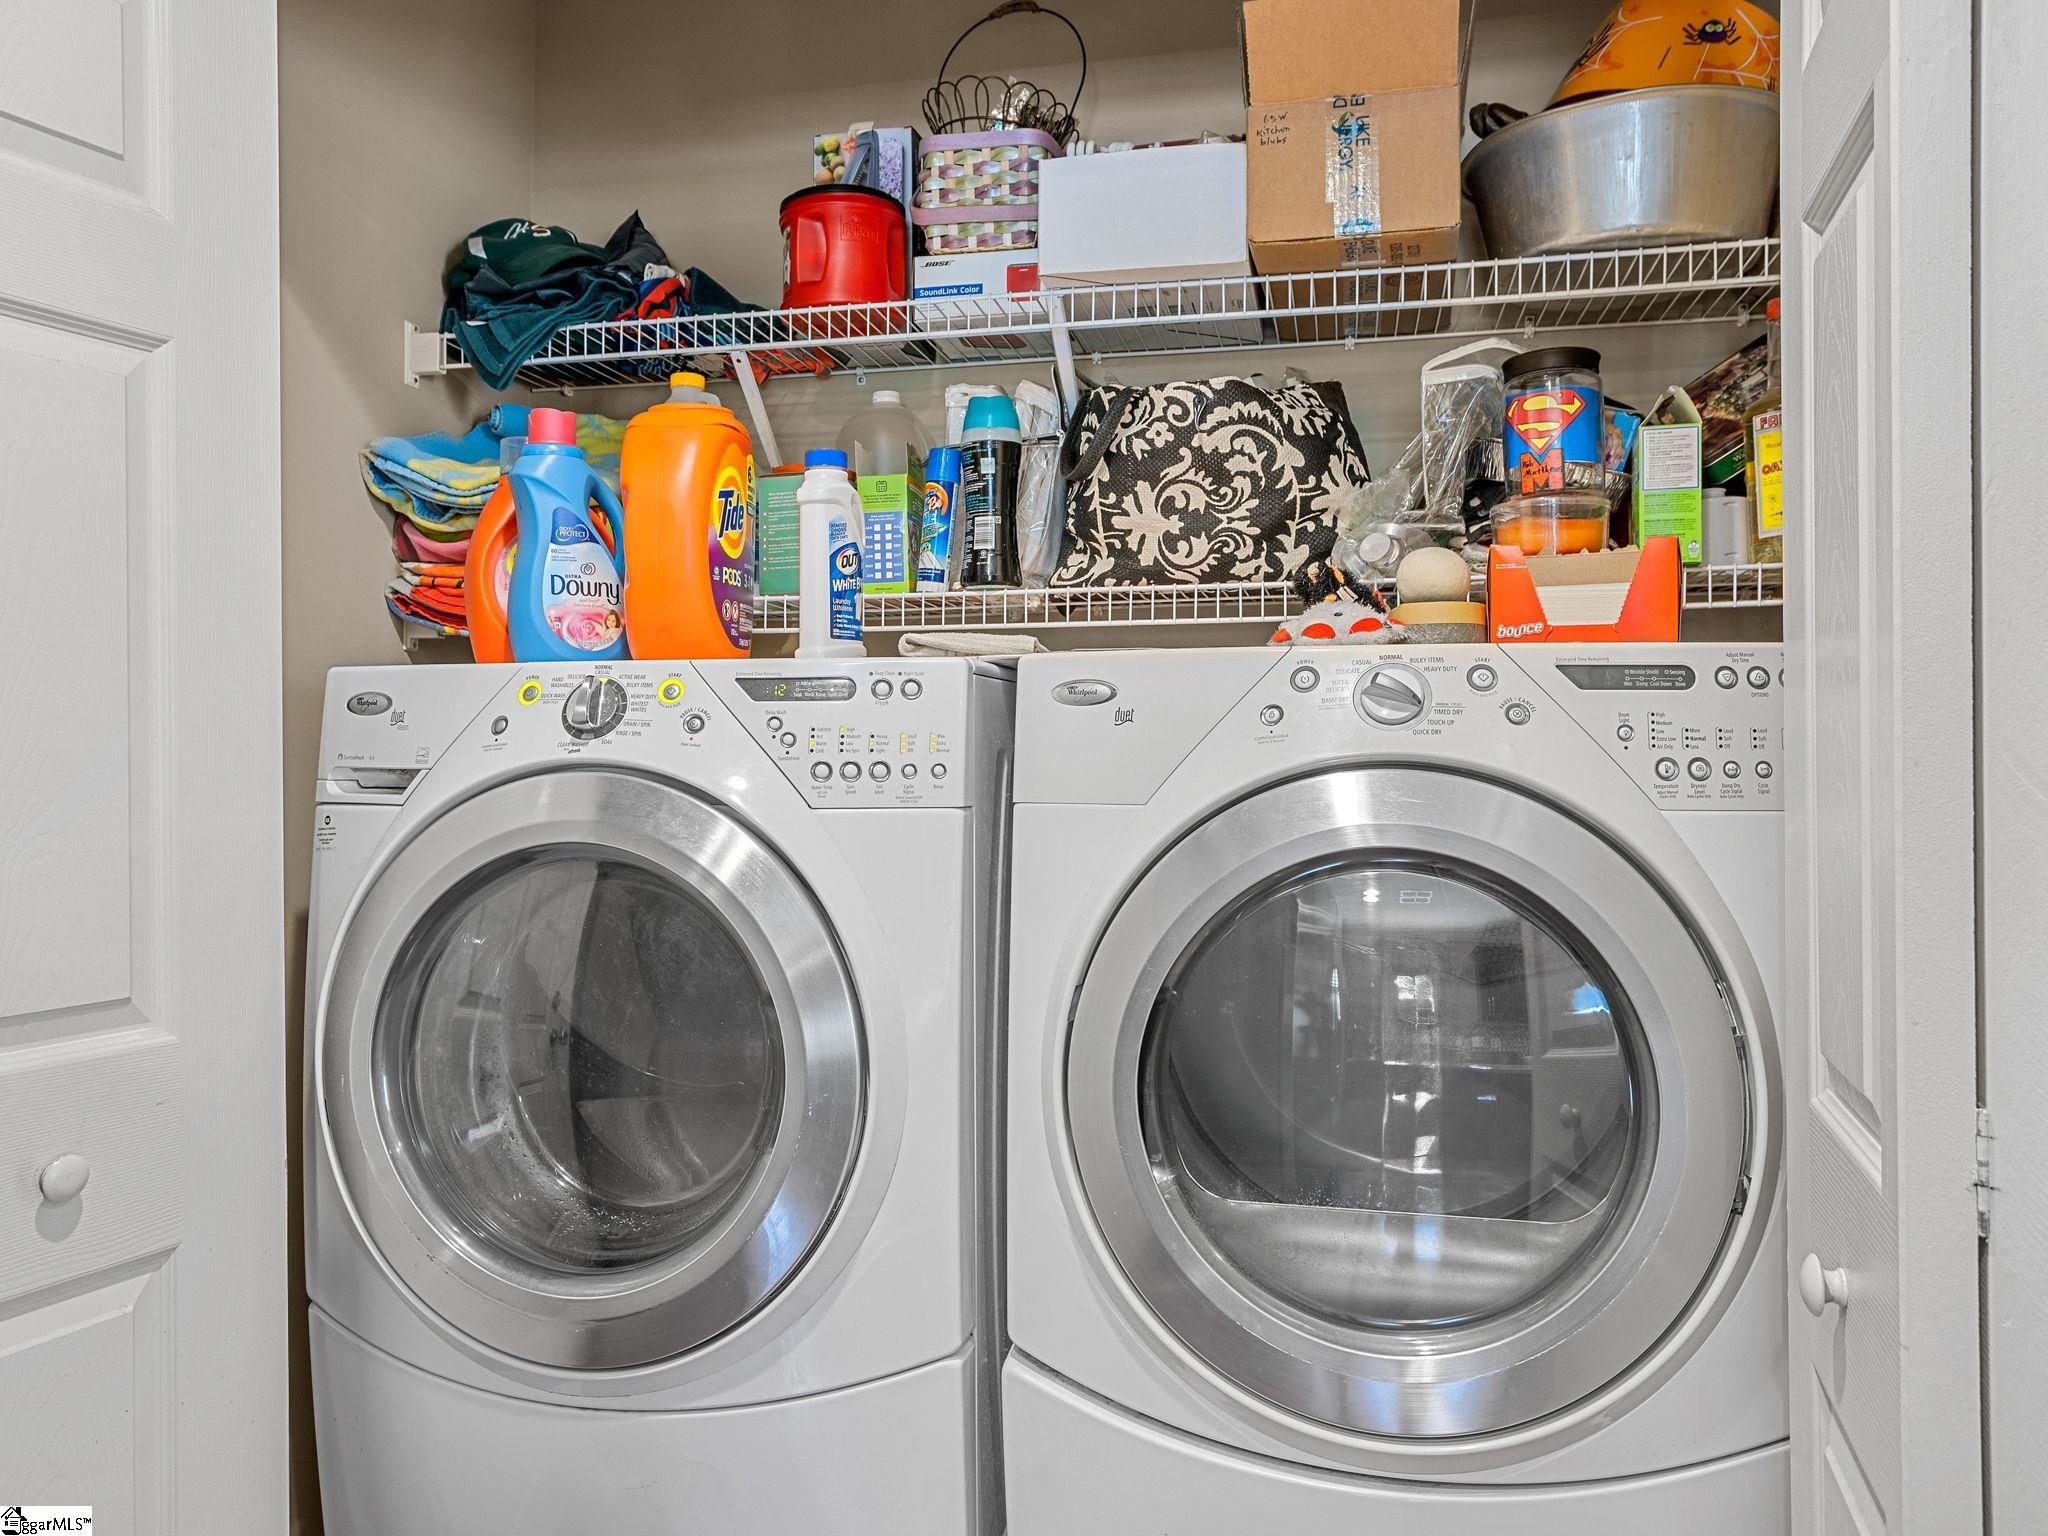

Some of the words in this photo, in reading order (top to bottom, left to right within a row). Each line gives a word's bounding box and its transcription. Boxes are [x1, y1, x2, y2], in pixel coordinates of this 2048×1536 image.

[920, 260, 955, 268] BOSE
[919, 287, 958, 297] SoundLink
[960, 286, 980, 294] Color
[717, 489, 745, 540] Tide
[559, 530, 586, 538] PROTECT
[841, 552, 859, 569] OUT
[722, 566, 742, 588] PODS
[551, 574, 621, 606] Downy
[1496, 622, 1544, 639] bounce
[1067, 689, 1098, 698] Whirlpool
[680, 707, 693, 719] PAUSE
[1498, 697, 1514, 710] PAUSE
[1518, 697, 1537, 713] CANCEL
[390, 708, 407, 725] duet
[1114, 707, 1135, 726] duet
[1730, 788, 1743, 796] Signal
